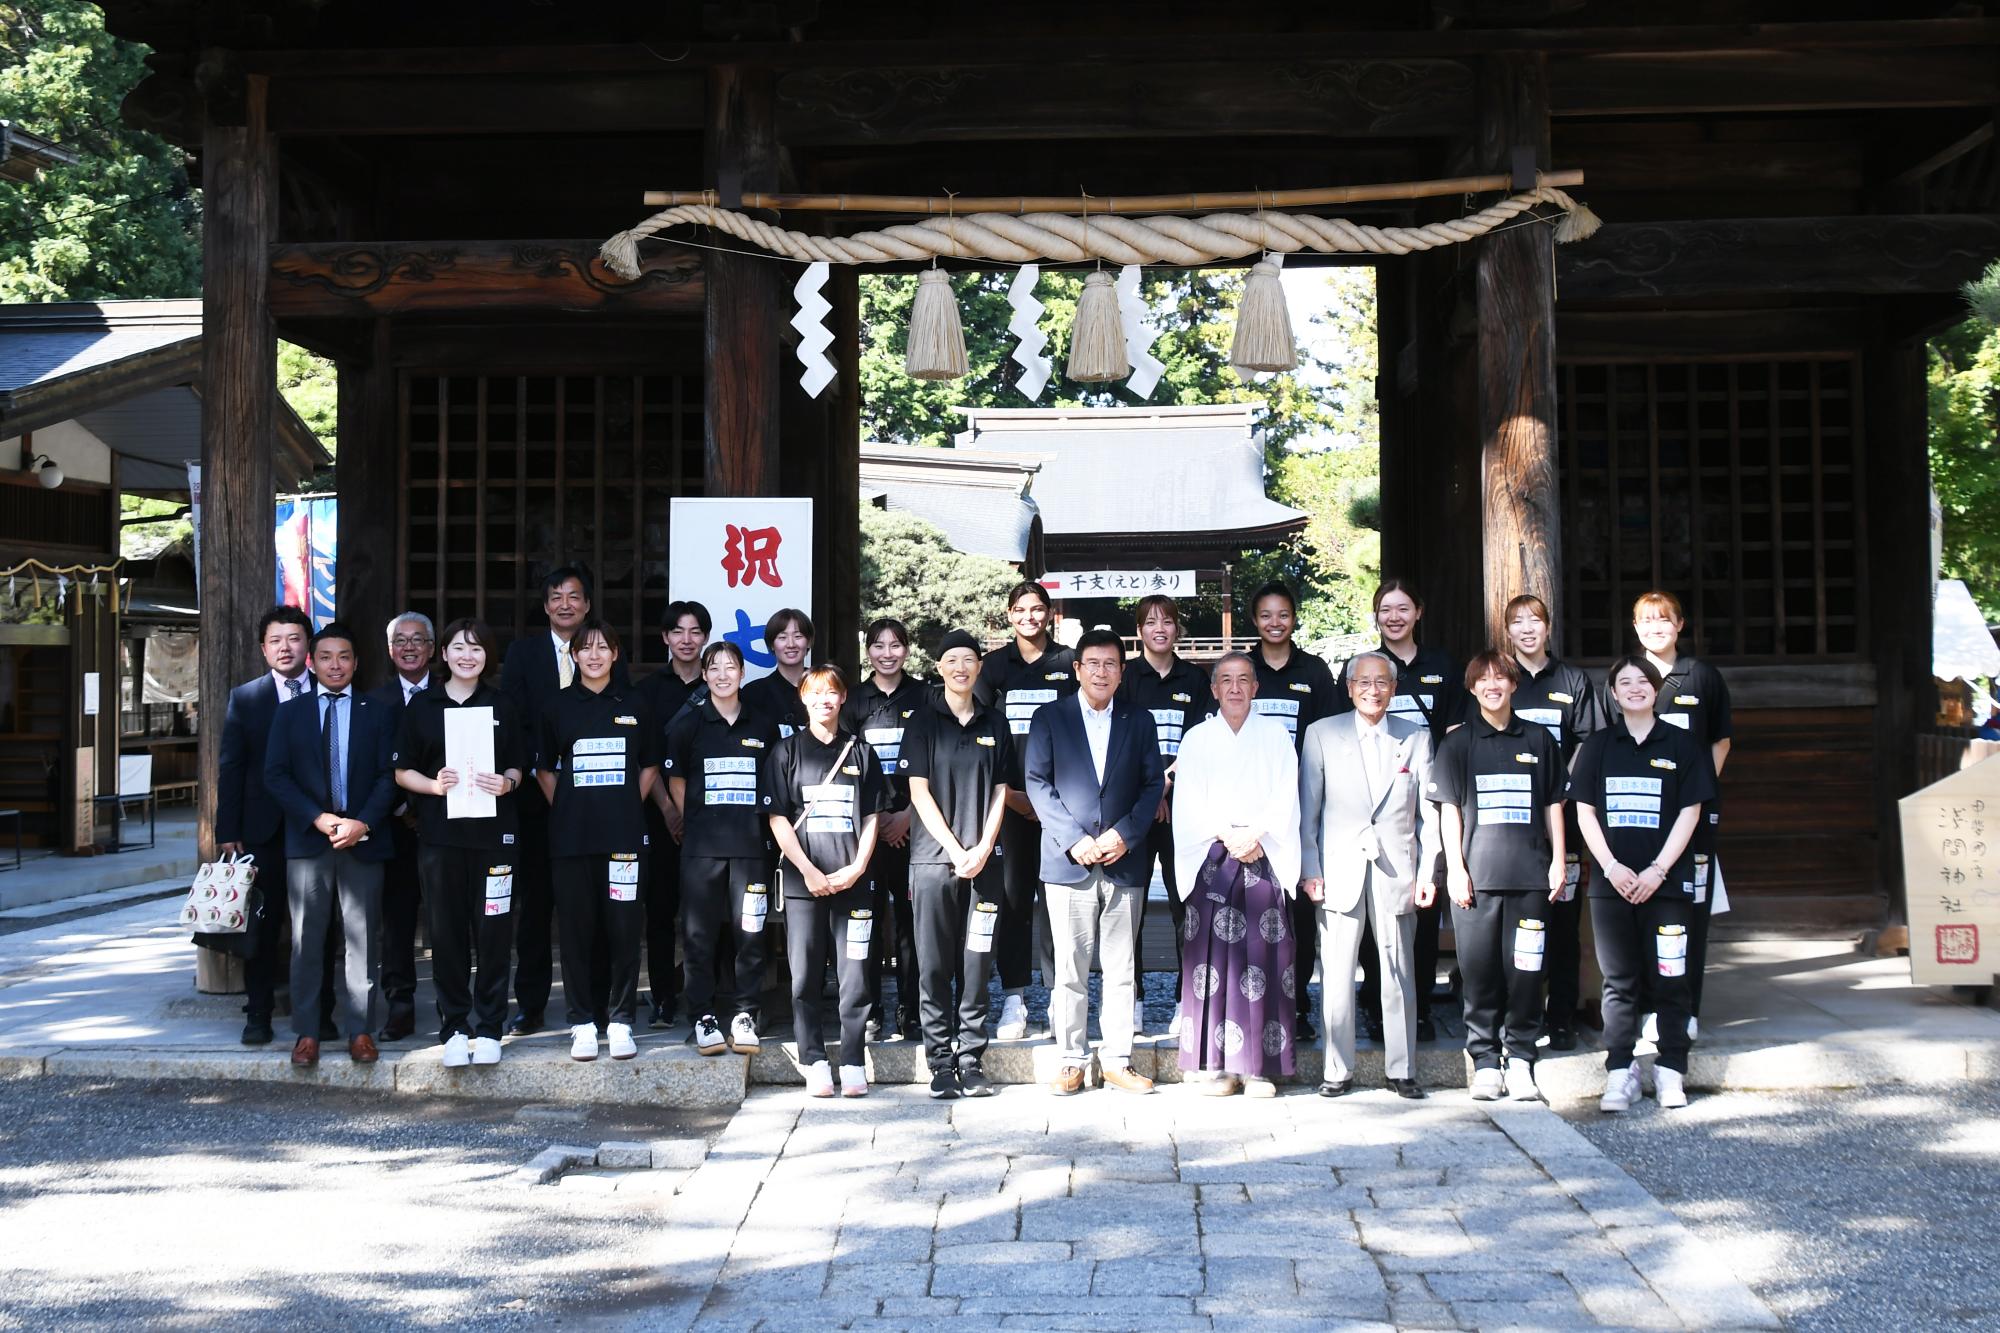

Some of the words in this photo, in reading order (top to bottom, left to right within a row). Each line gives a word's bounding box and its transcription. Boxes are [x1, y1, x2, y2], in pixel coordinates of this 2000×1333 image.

[720, 523, 783, 588] 祝
[586, 740, 624, 751] 日本免税
[719, 760, 755, 770] 日本免税
